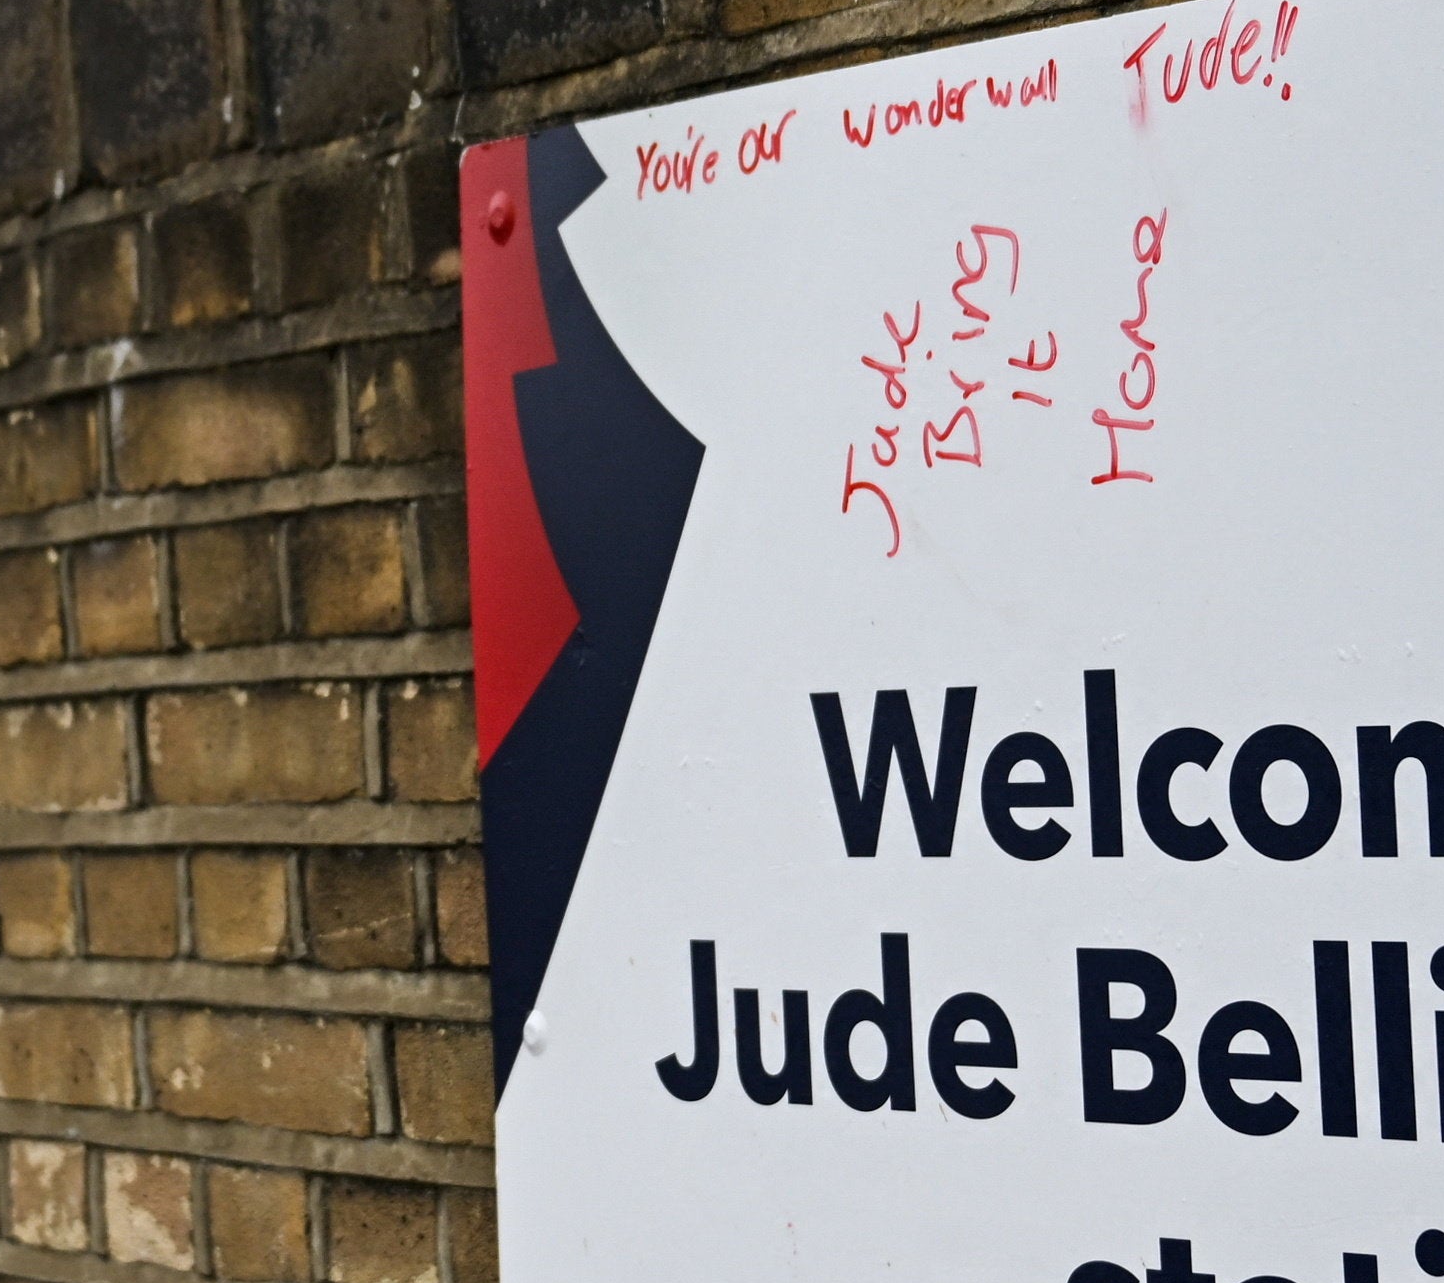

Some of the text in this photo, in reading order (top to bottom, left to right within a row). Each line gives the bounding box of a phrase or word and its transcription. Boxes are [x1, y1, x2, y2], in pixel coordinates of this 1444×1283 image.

[737, 110, 797, 175] our
[1123, 0, 1300, 122] Jude!!
[923, 224, 1019, 469] Bring
[1091, 208, 1168, 486] Home
[655, 932, 1018, 1120] Jude
